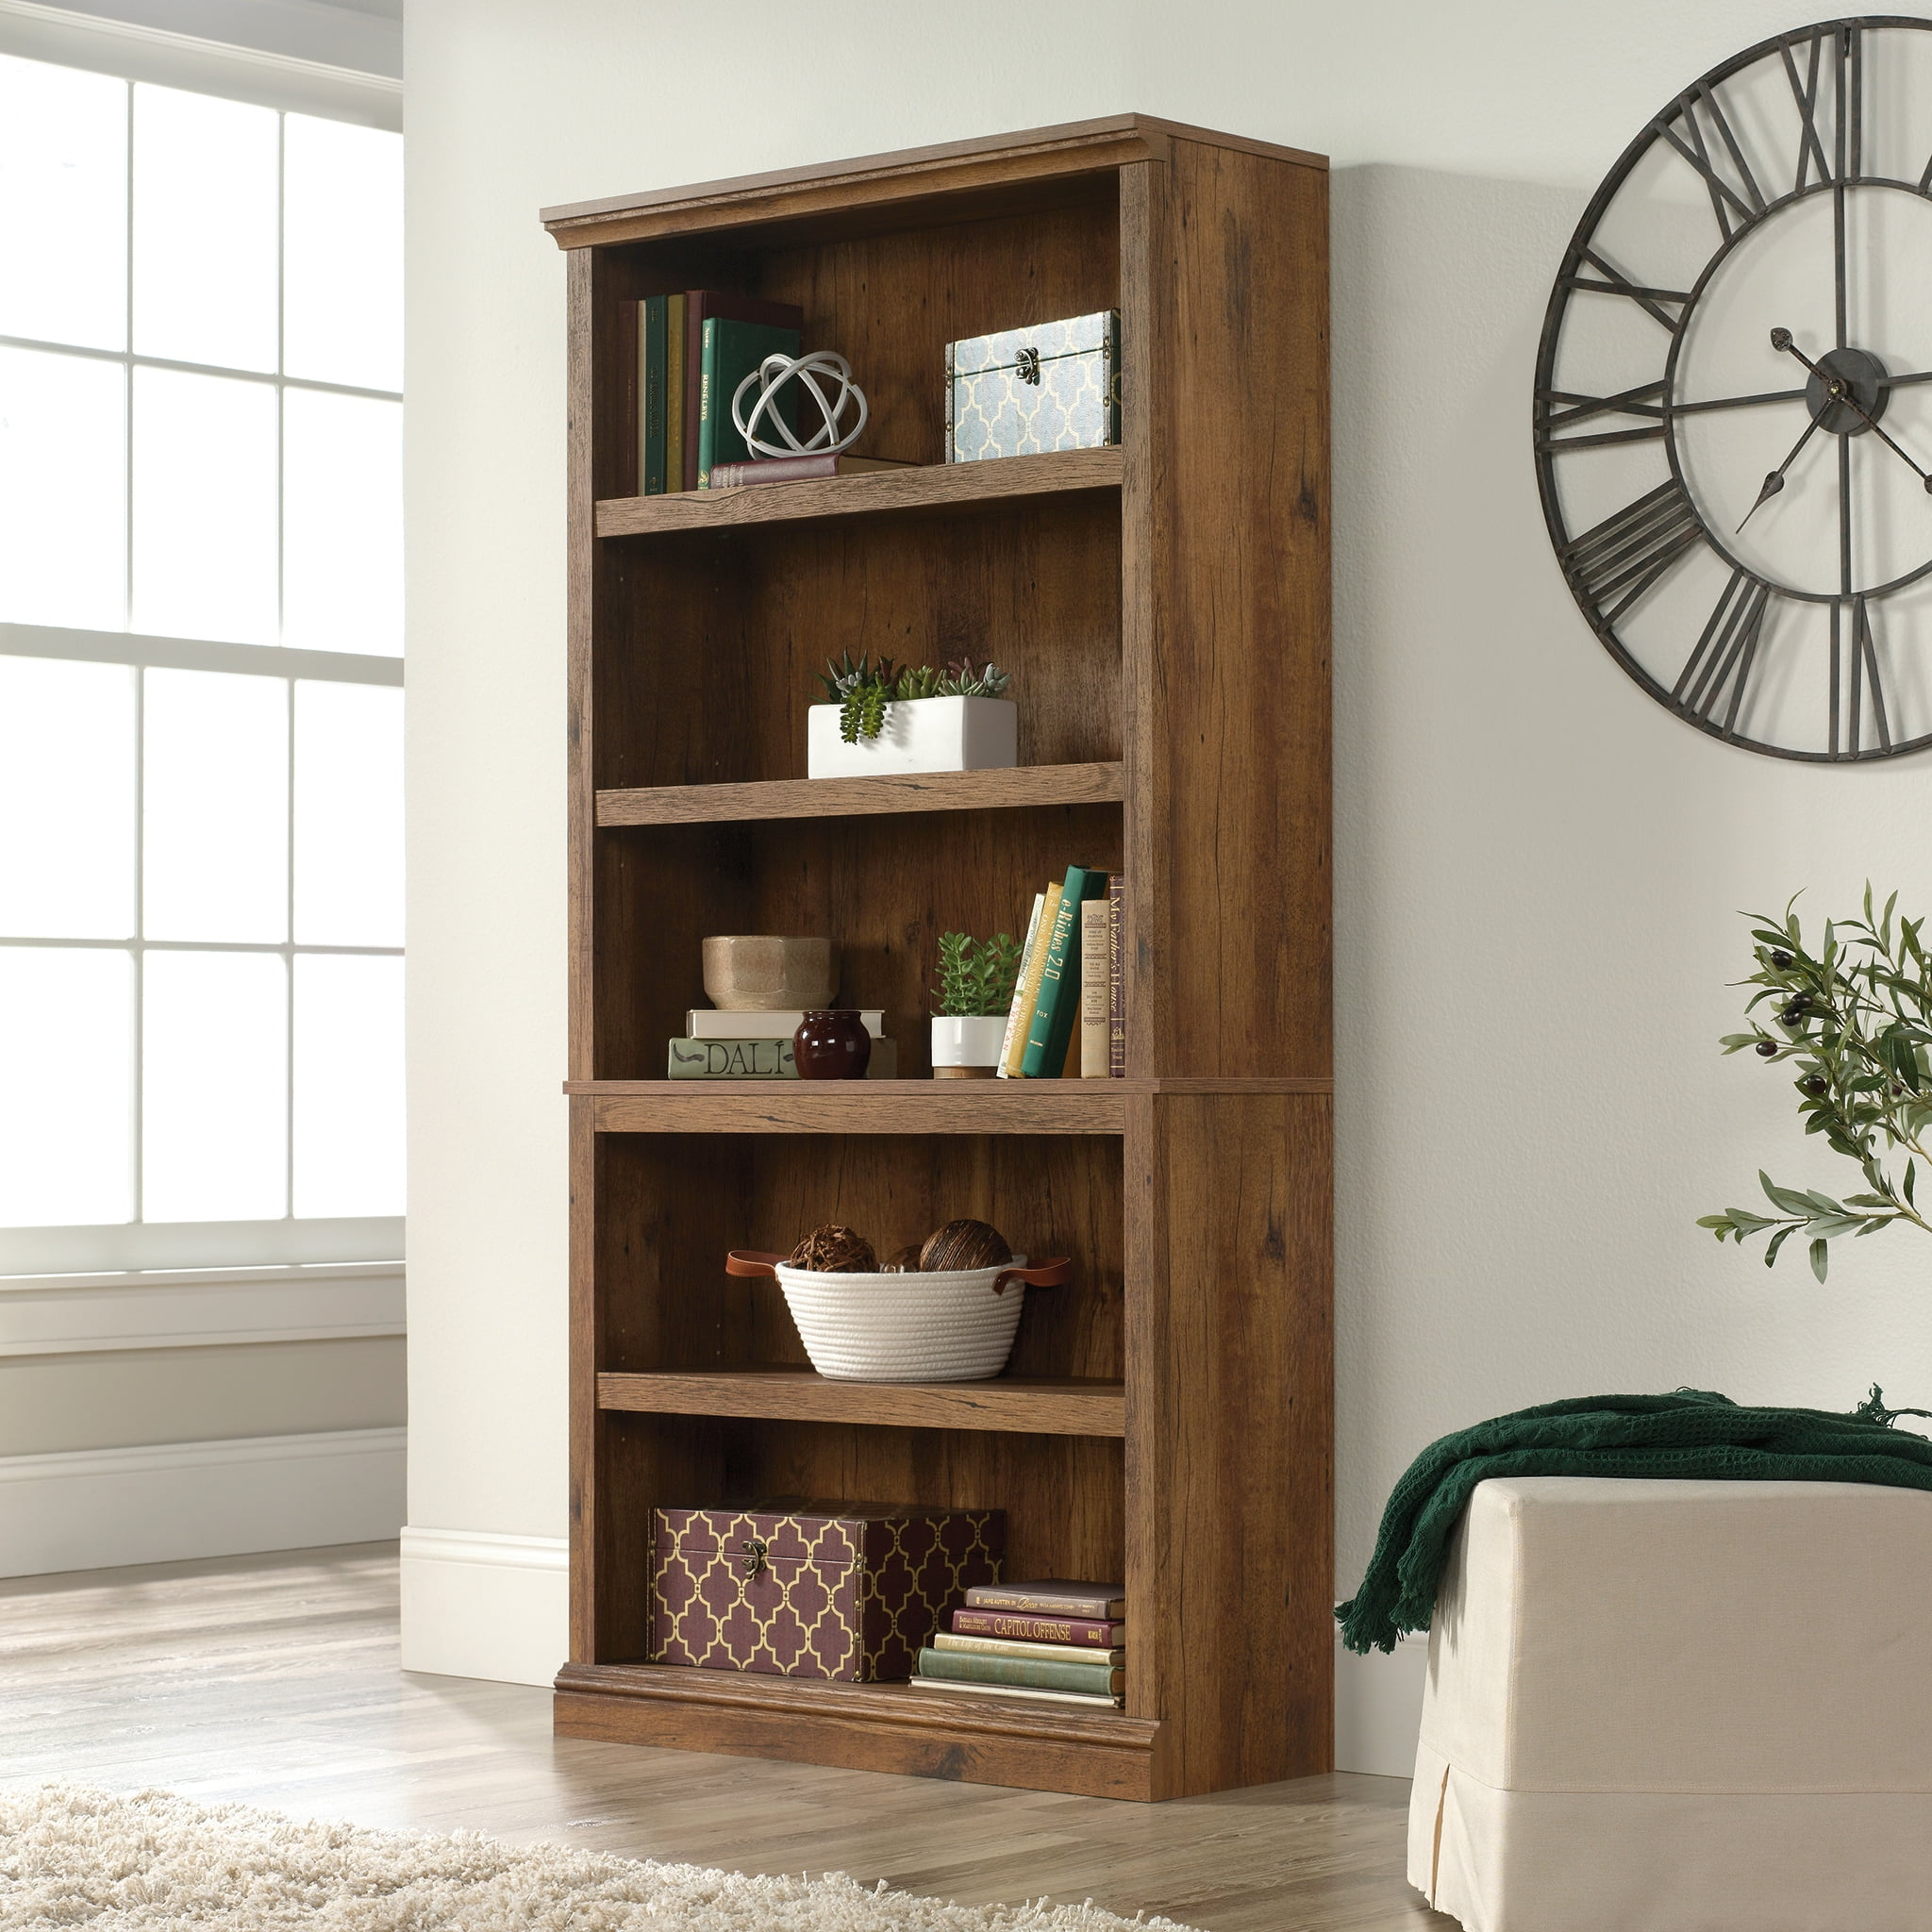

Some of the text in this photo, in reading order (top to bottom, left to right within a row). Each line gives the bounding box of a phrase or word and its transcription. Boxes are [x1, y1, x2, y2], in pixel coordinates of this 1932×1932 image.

[1050, 899, 1073, 952] e-Riches
[1044, 955, 1063, 980] 2.0
[1110, 897, 1120, 1012] My Father's House
[703, 1040, 785, 1074] DALÍ
[993, 1618, 1032, 1638] CAPITOL
[1033, 1622, 1072, 1641] OFFENSE
